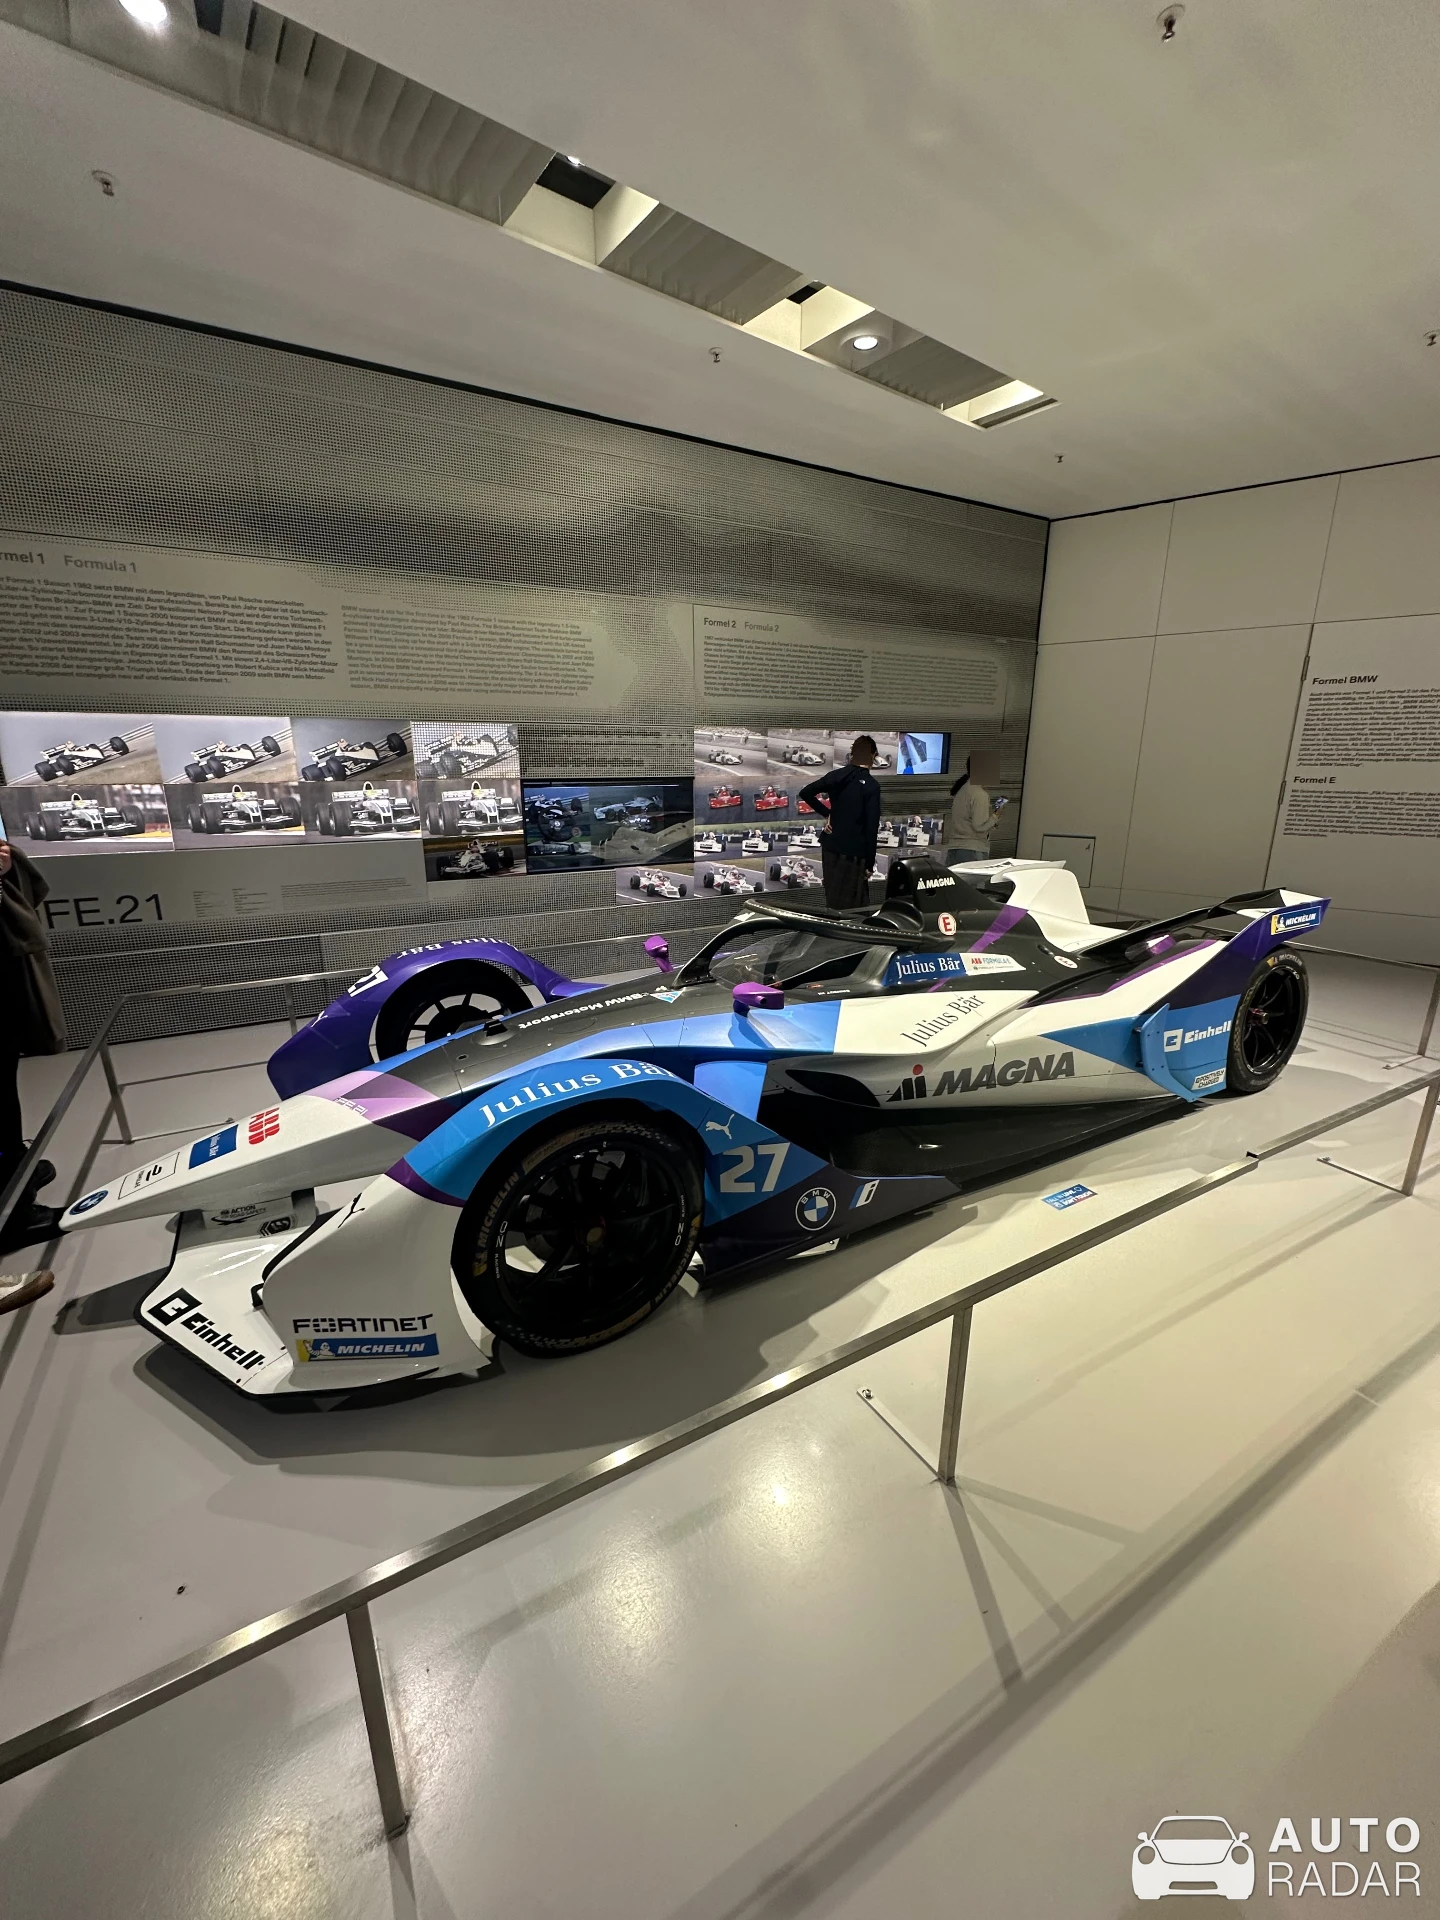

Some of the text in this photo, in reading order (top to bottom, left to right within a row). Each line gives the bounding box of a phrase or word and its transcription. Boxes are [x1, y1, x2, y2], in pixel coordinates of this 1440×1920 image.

[37, 552, 45, 564] 1
[63, 555, 138, 573] Formula 1
[703, 617, 737, 629] Formel 2
[744, 621, 780, 633] Formula 2
[1312, 675, 1379, 685] Formel BMW
[1293, 776, 1337, 784] Formel E
[926, 877, 956, 889] MAGNA
[35, 893, 163, 929] FE.21
[1285, 913, 1317, 926] MICHELIN
[941, 916, 952, 932] E
[895, 957, 960, 979] Julius Bär
[605, 992, 643, 1007] BMW
[518, 1002, 604, 1030] Motorsport
[900, 994, 985, 1047] Julius Bär
[1184, 1020, 1232, 1044] Einhell
[932, 1051, 1075, 1096] MAGNA
[479, 1074, 602, 1128] Julius
[248, 1107, 281, 1145] ABB
[719, 1142, 791, 1193] 27
[800, 1189, 831, 1205] BMW
[477, 1172, 519, 1249] MICHELIN
[292, 1313, 434, 1334] FORTINET
[180, 1312, 266, 1370] Einhell
[337, 1342, 426, 1355] MICHELIN
